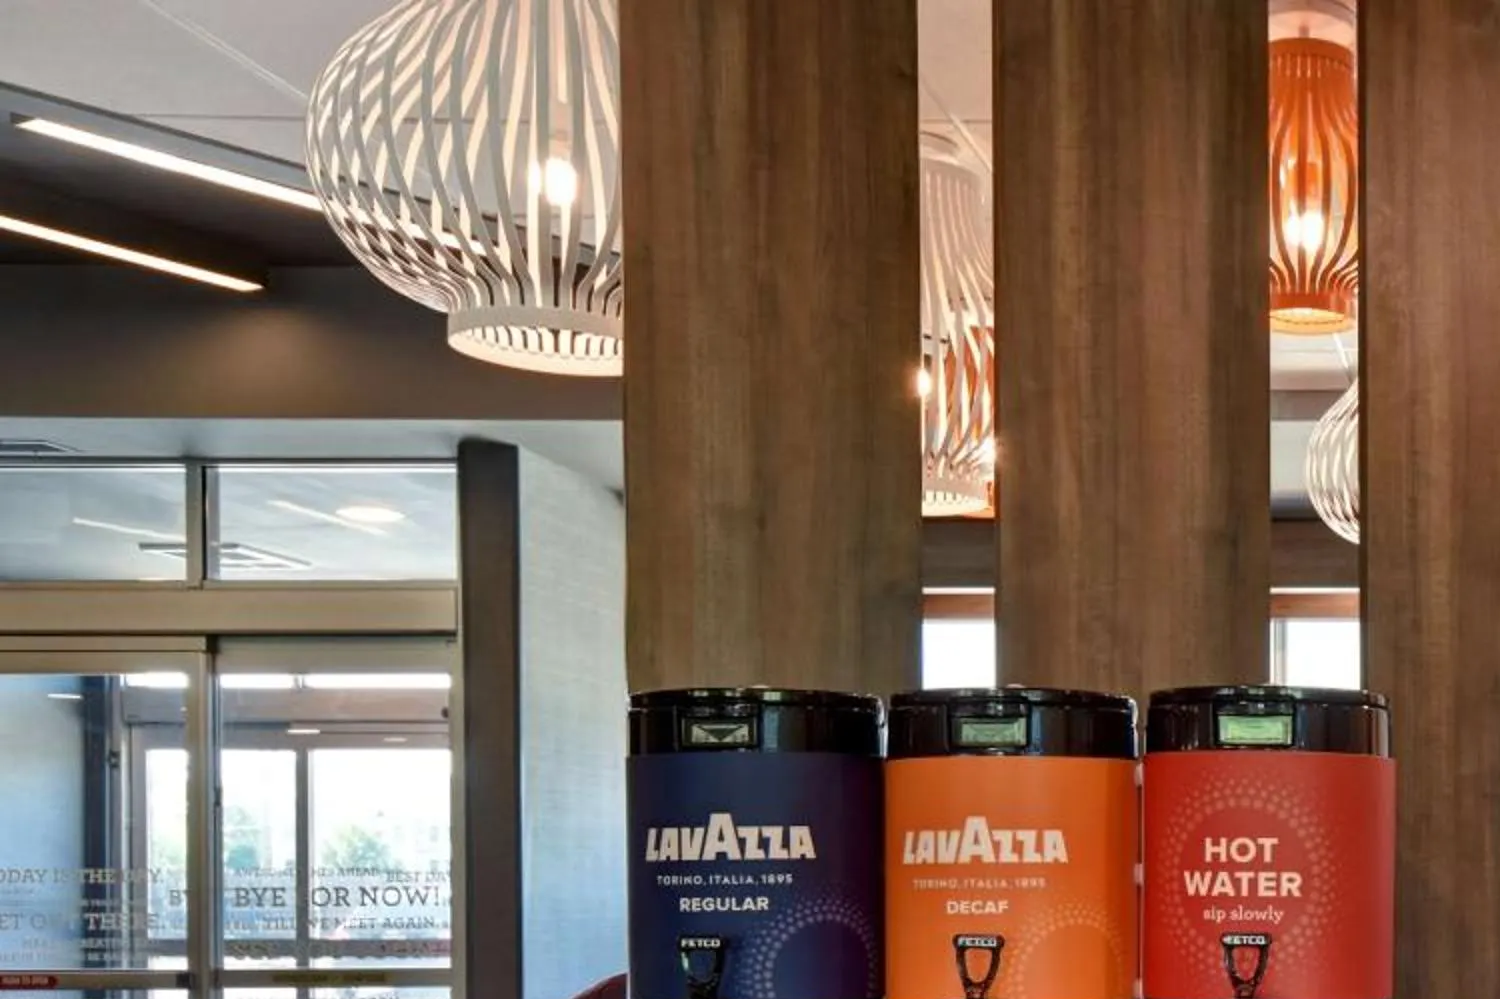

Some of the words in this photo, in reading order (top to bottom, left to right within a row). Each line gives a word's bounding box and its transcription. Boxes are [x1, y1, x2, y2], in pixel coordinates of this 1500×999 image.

[645, 812, 817, 862] LAVAZZA
[902, 816, 1069, 865] LAVAZZA
[1204, 837, 1280, 863] HOT
[77, 868, 117, 884] THE
[761, 873, 794, 885] 1895
[1183, 870, 1303, 898] WATER
[234, 887, 287, 907] BYE
[309, 886, 351, 907] OR
[358, 885, 441, 908] NOW!
[679, 896, 770, 913] REGULAR
[946, 900, 1010, 915] DECAF
[1203, 905, 1226, 924] sip
[1230, 904, 1285, 925] slowly
[680, 937, 722, 949] FETCO
